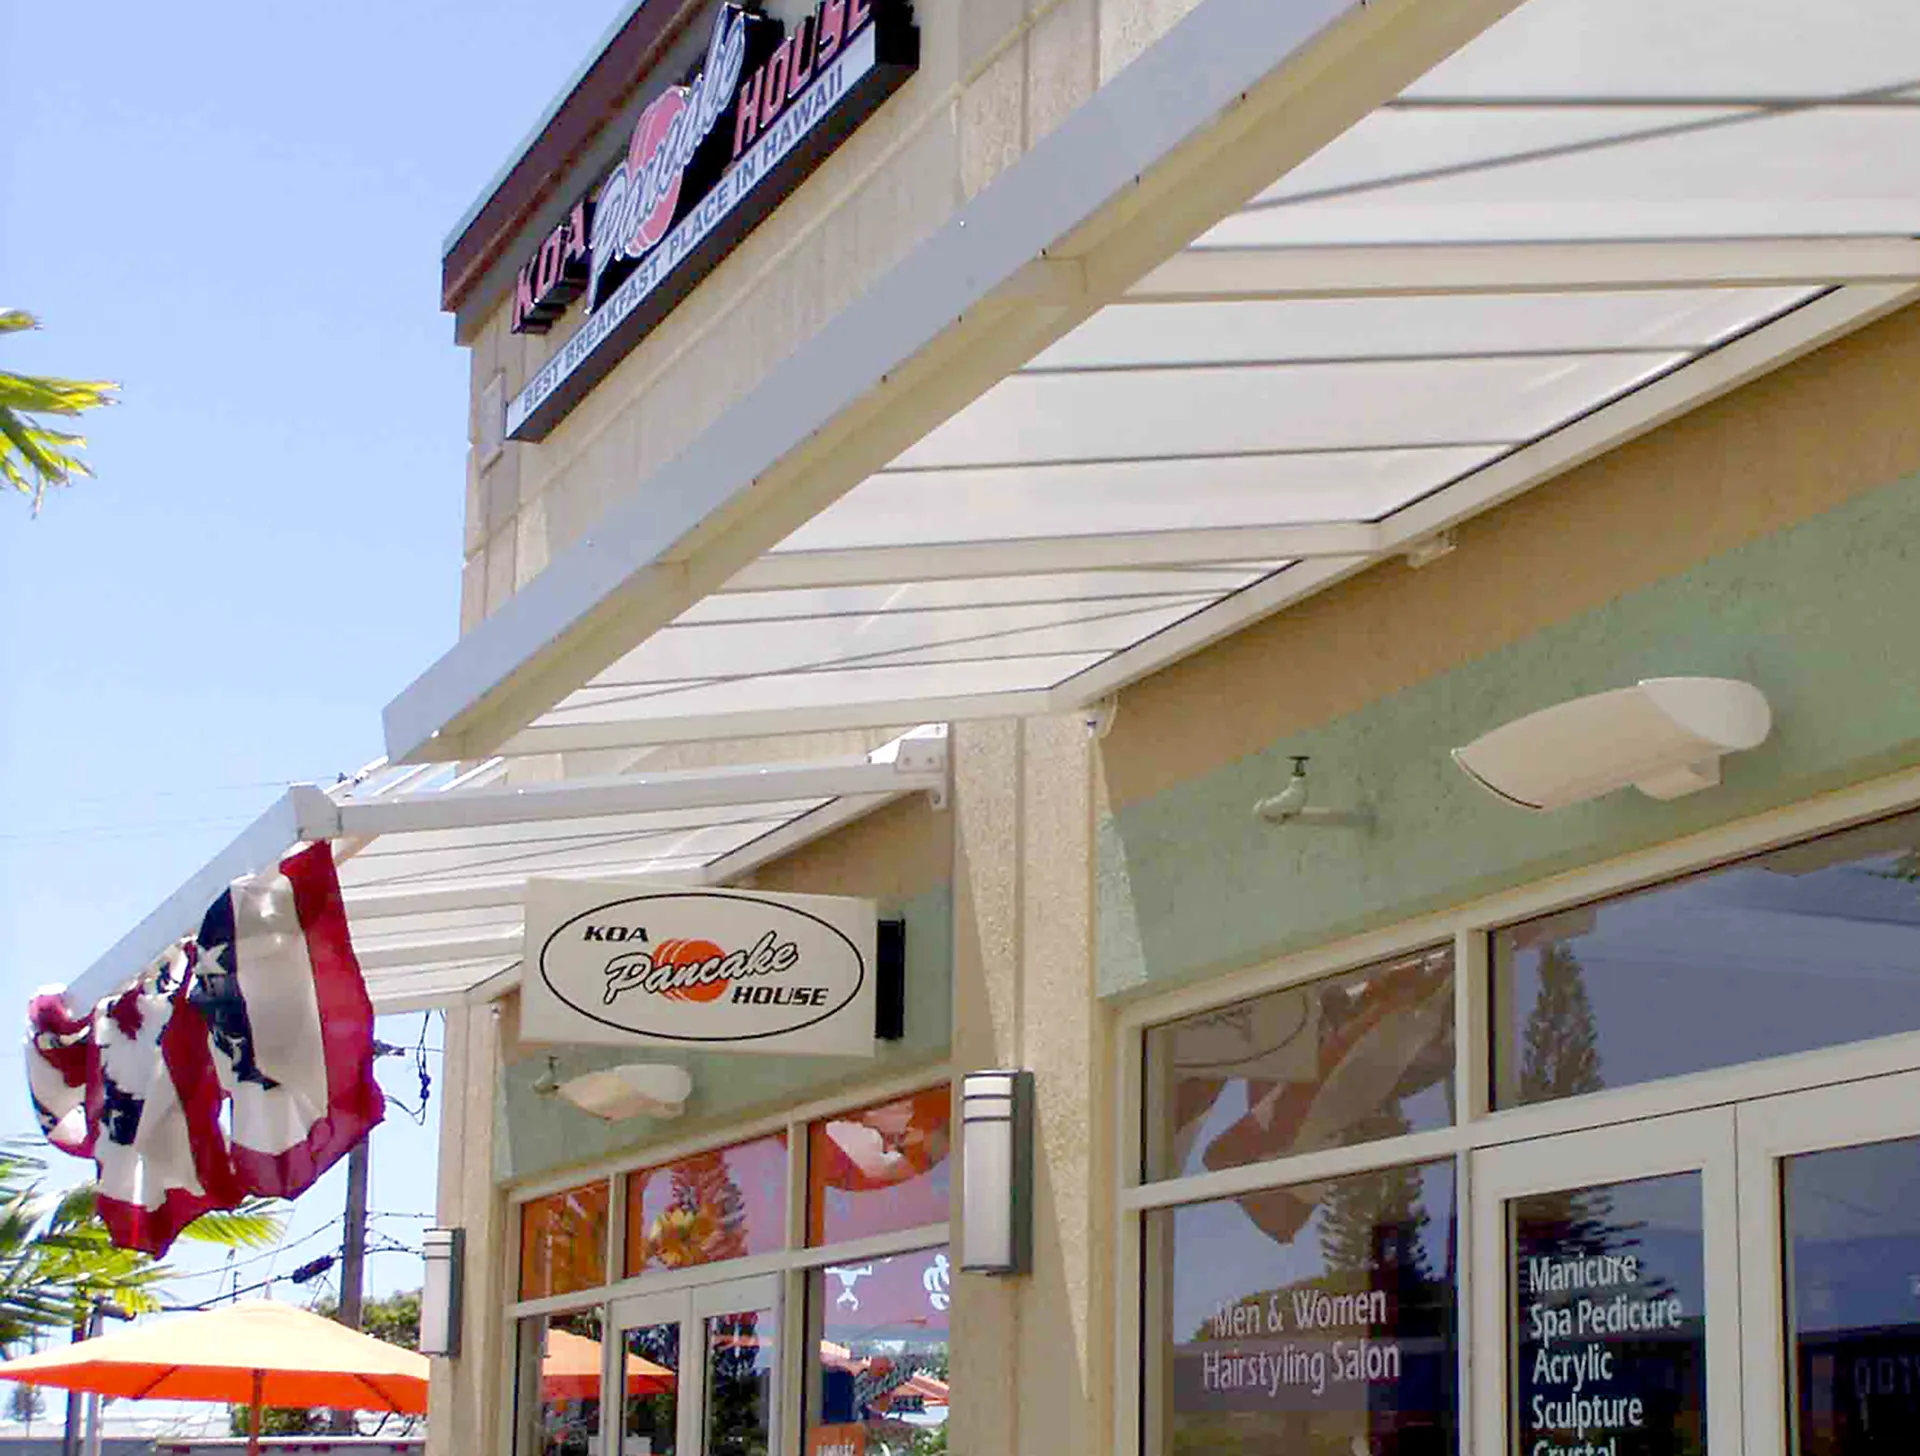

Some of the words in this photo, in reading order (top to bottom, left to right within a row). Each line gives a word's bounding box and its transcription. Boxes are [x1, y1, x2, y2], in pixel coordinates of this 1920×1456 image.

[584, 2, 745, 315] Pancake
[522, 363, 560, 413] BEST
[565, 255, 662, 371] BREAKFAST
[669, 183, 729, 263] PLACE
[735, 158, 756, 194] IN
[762, 63, 843, 166] HAWAII
[511, 202, 586, 334] KOA
[583, 926, 649, 942] KOA
[603, 930, 799, 1005] Pancake
[732, 986, 830, 1006] HOUSE
[1529, 1252, 1638, 1293] Manicure
[1212, 1298, 1261, 1338] Men
[1266, 1295, 1284, 1333] &
[1291, 1288, 1388, 1330] Women
[1530, 1302, 1572, 1348] Spa
[1578, 1294, 1683, 1335] Pedicure
[1202, 1343, 1326, 1398] Hairstyling
[1331, 1338, 1401, 1382] Salon
[1532, 1343, 1614, 1392] Acrylic
[1531, 1393, 1644, 1440] Sculpture
